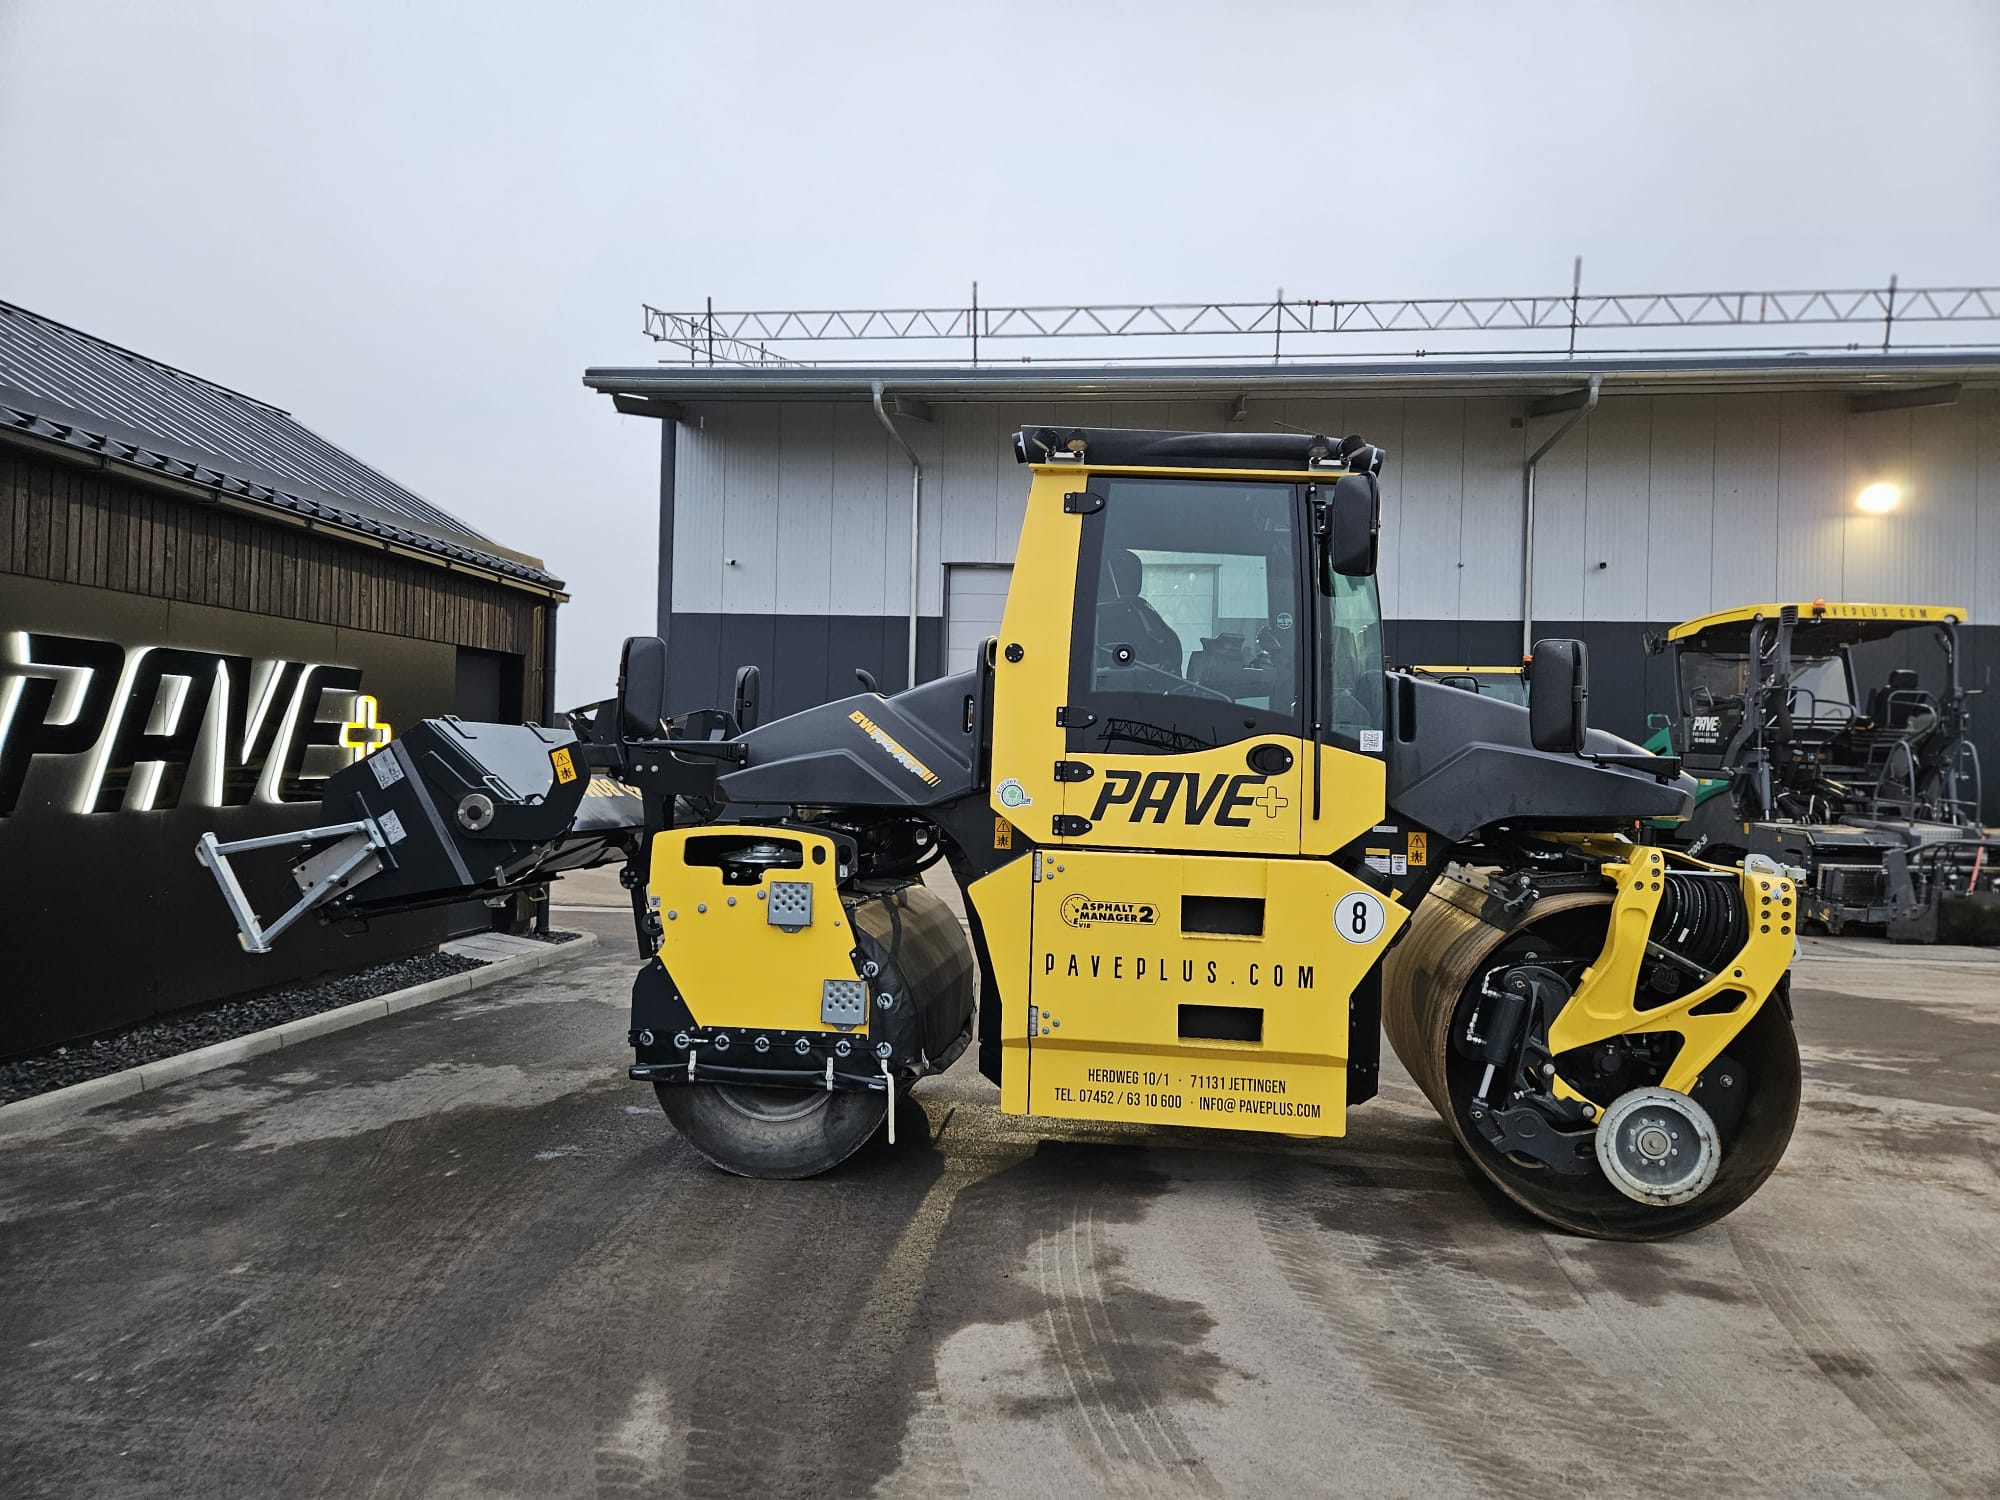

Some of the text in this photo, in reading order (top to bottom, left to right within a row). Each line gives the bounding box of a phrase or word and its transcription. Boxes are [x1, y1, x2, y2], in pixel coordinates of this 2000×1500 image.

[1079, 906, 1154, 923] MANAGER 2
[1081, 902, 1134, 913] ASPHALT
[1352, 901, 1367, 934] 8
[1045, 953, 1314, 989] PAVEPLUS.COM
[1088, 1068, 1286, 1094] HERDWEG 10/1 71131 JETTINGEN
[1054, 1087, 1076, 1102] TEL.
[1079, 1089, 1114, 1105] 07452
[1127, 1092, 1141, 1106] 63
[1145, 1093, 1158, 1107] 10
[1161, 1094, 1182, 1109] 600
